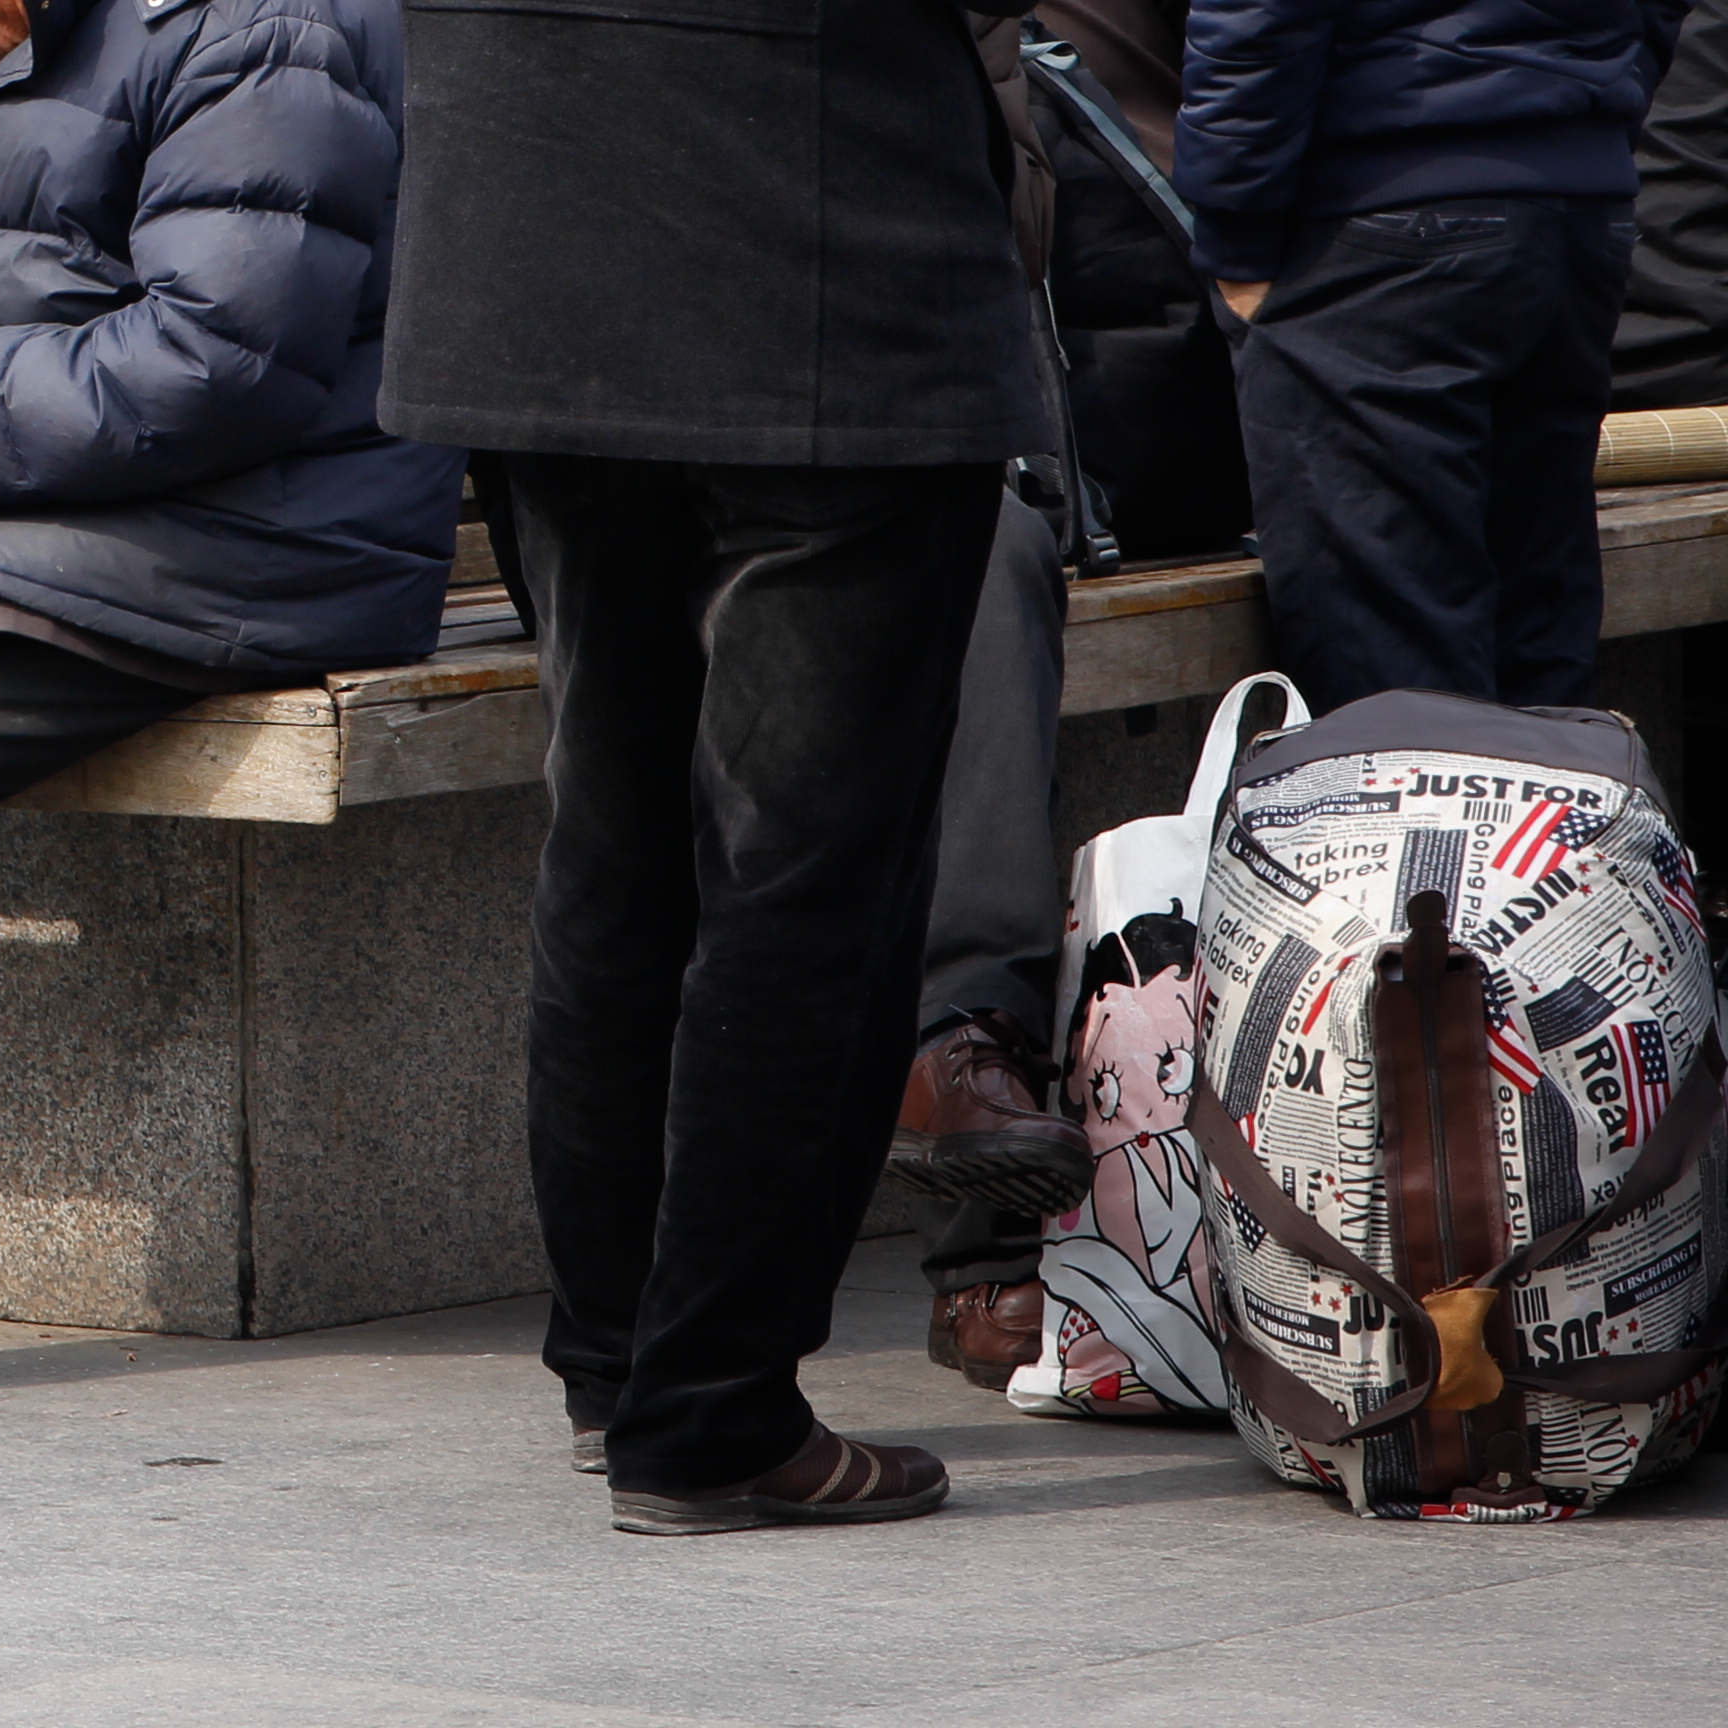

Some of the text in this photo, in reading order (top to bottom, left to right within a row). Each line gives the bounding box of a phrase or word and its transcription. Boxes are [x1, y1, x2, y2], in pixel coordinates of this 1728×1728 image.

[1406, 773, 1604, 810] JUST FOR
[1294, 841, 1390, 871] taking
[1467, 823, 1496, 892] Going
[1215, 911, 1267, 964] taking
[1497, 1084, 1516, 1183] Place
[1611, 1247, 1689, 1298] SUBSCRIBING
[1257, 1313, 1333, 1351] SUBSCRIBING
